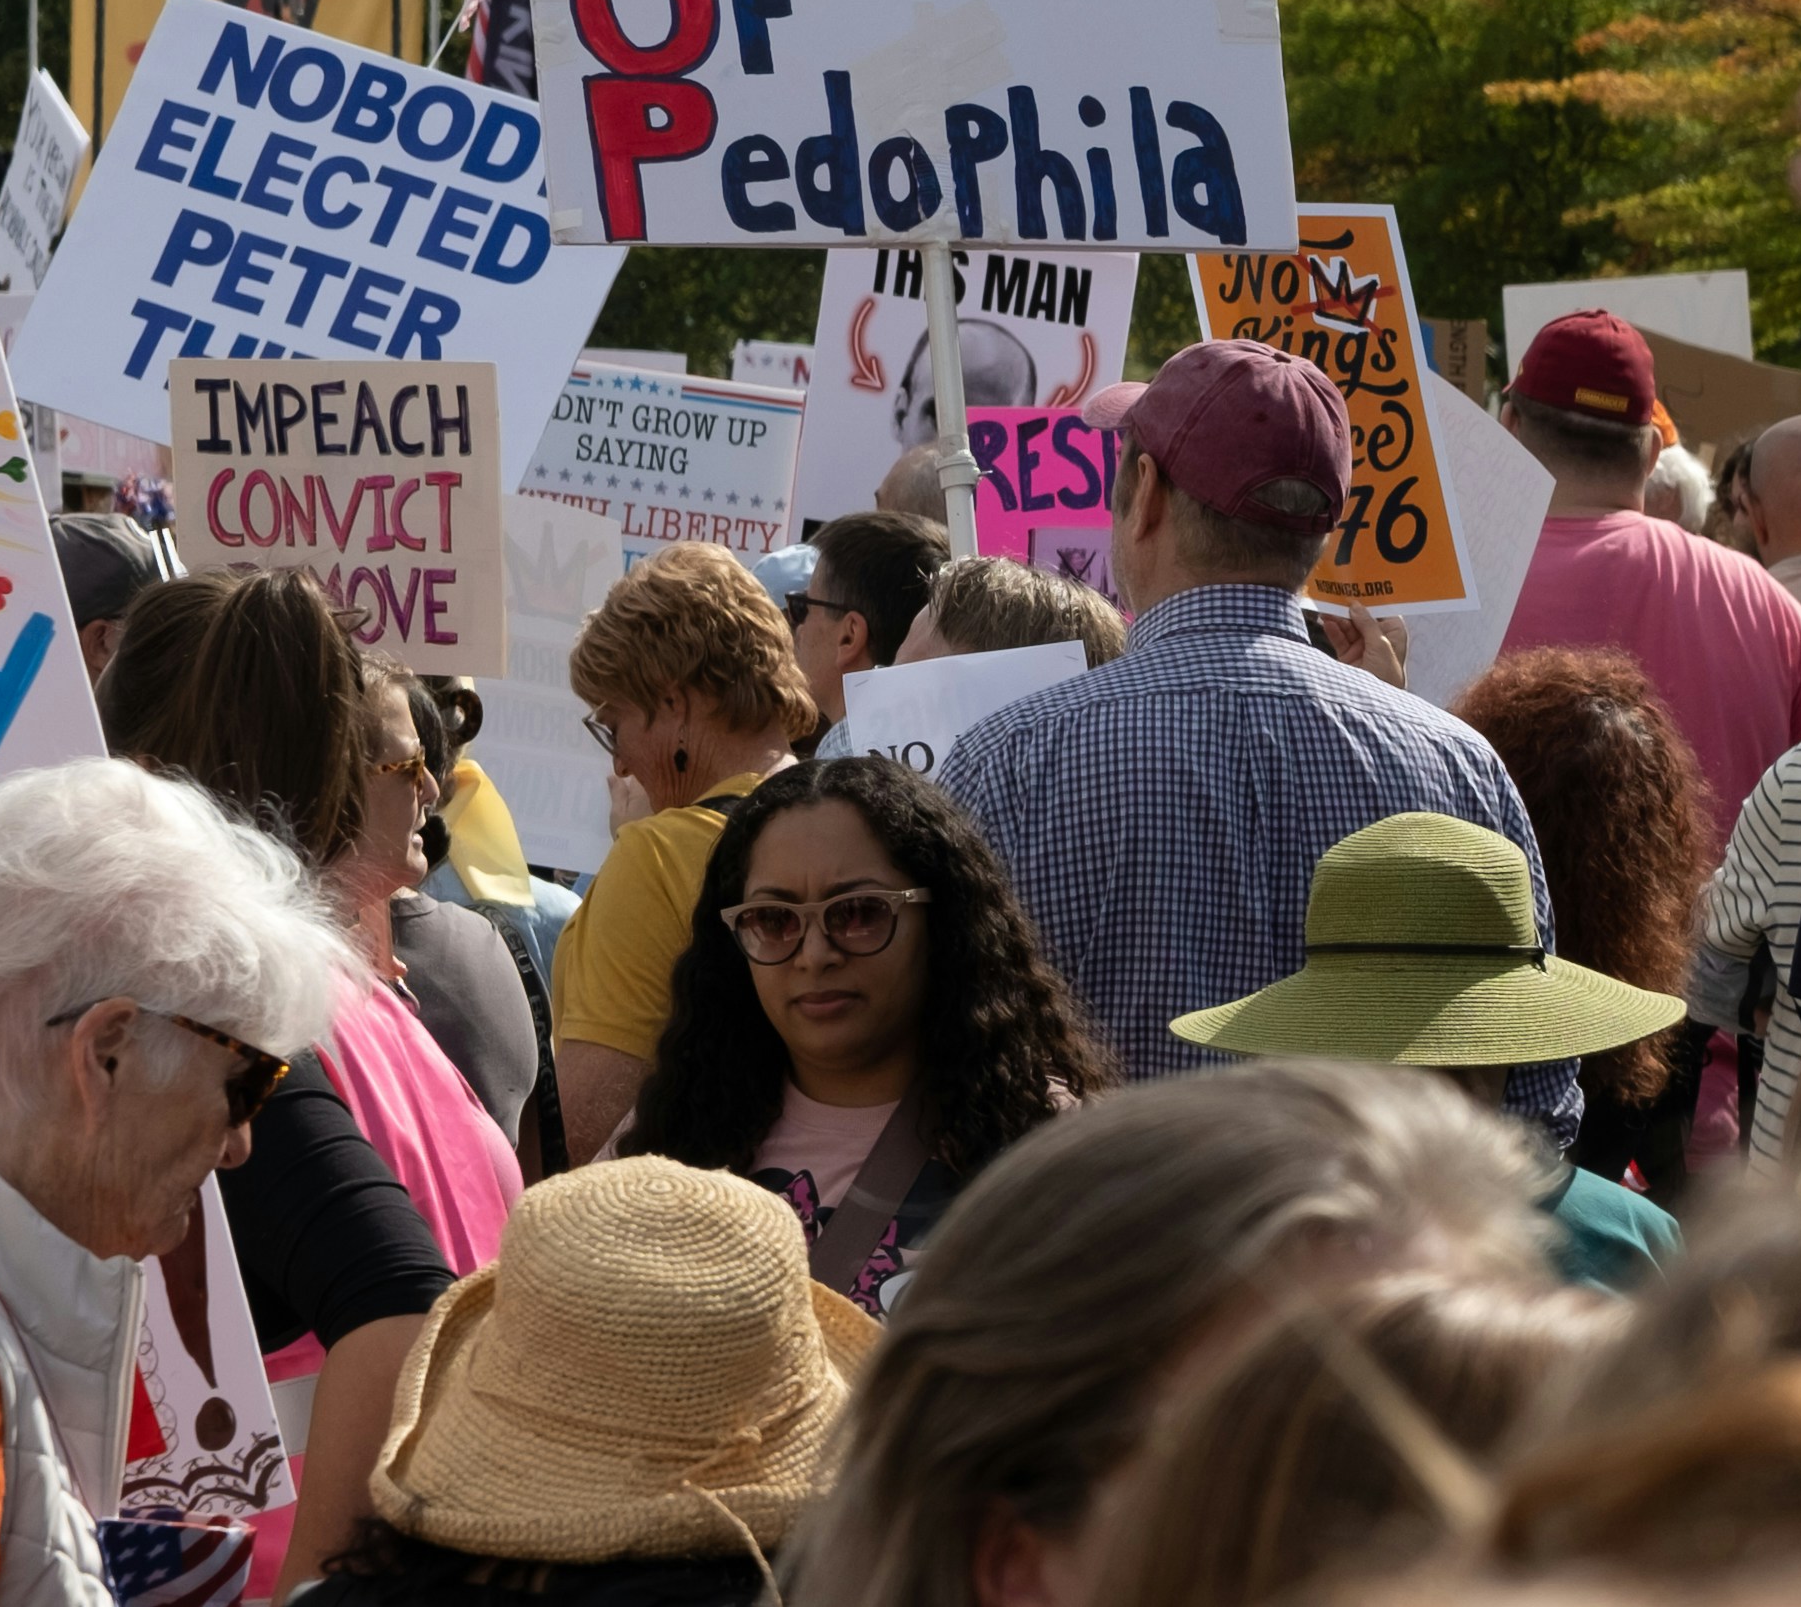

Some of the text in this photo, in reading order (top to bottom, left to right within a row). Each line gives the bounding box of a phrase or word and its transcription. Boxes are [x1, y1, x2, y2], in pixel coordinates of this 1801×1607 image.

[197, 20, 547, 198] NOBOD
[135, 99, 552, 285] ELECTED
[151, 209, 462, 362] PETER
[981, 253, 1093, 327] MAN
[194, 377, 473, 458] IMPEACH
[575, 434, 690, 476] SAYING
[632, 403, 719, 443] GROW
[727, 416, 769, 448] UP
[966, 414, 1122, 513] RESI
[207, 467, 463, 554] CONVICT
[621, 502, 783, 555] LIBERTY
[227, 560, 459, 645] MOVE
